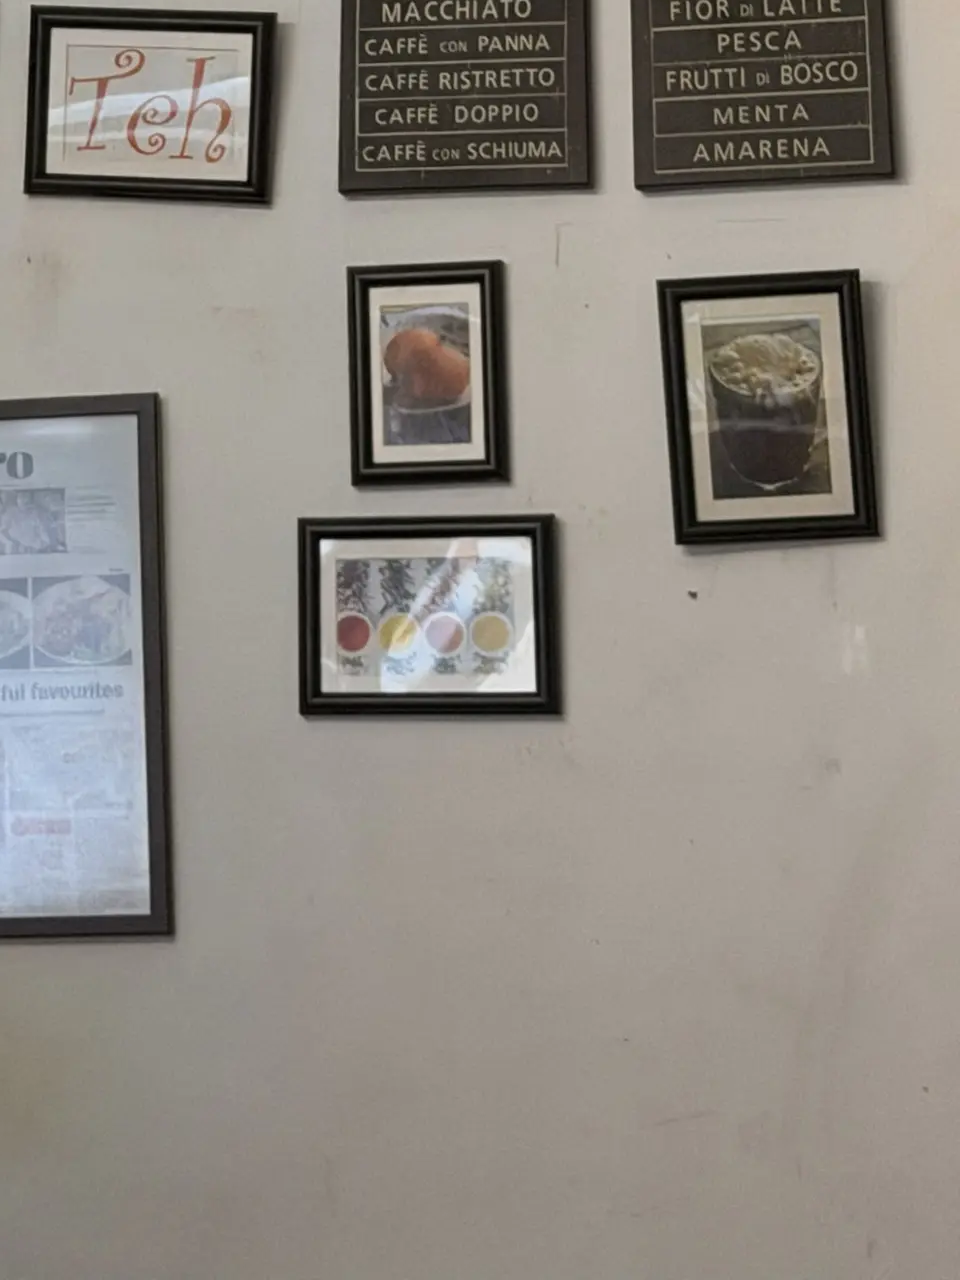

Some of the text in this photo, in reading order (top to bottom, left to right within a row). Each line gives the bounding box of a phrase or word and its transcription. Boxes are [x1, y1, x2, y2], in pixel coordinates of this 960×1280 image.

[364, 34, 550, 56] CAFFÈ CON PANNA
[717, 30, 802, 54] PESCA
[365, 67, 555, 92] CAFFÈ RISTRETTO
[666, 67, 746, 91] FRUTTI
[780, 60, 858, 86] BOSCO
[68, 48, 232, 163] Teh
[374, 103, 539, 125] CAFFÈ DOPPIO
[713, 103, 810, 126] MENTA
[362, 140, 563, 163] CAFFÈ CON SCHIUMA
[693, 137, 831, 163] AMARENA
[31, 681, 124, 701] favourites
